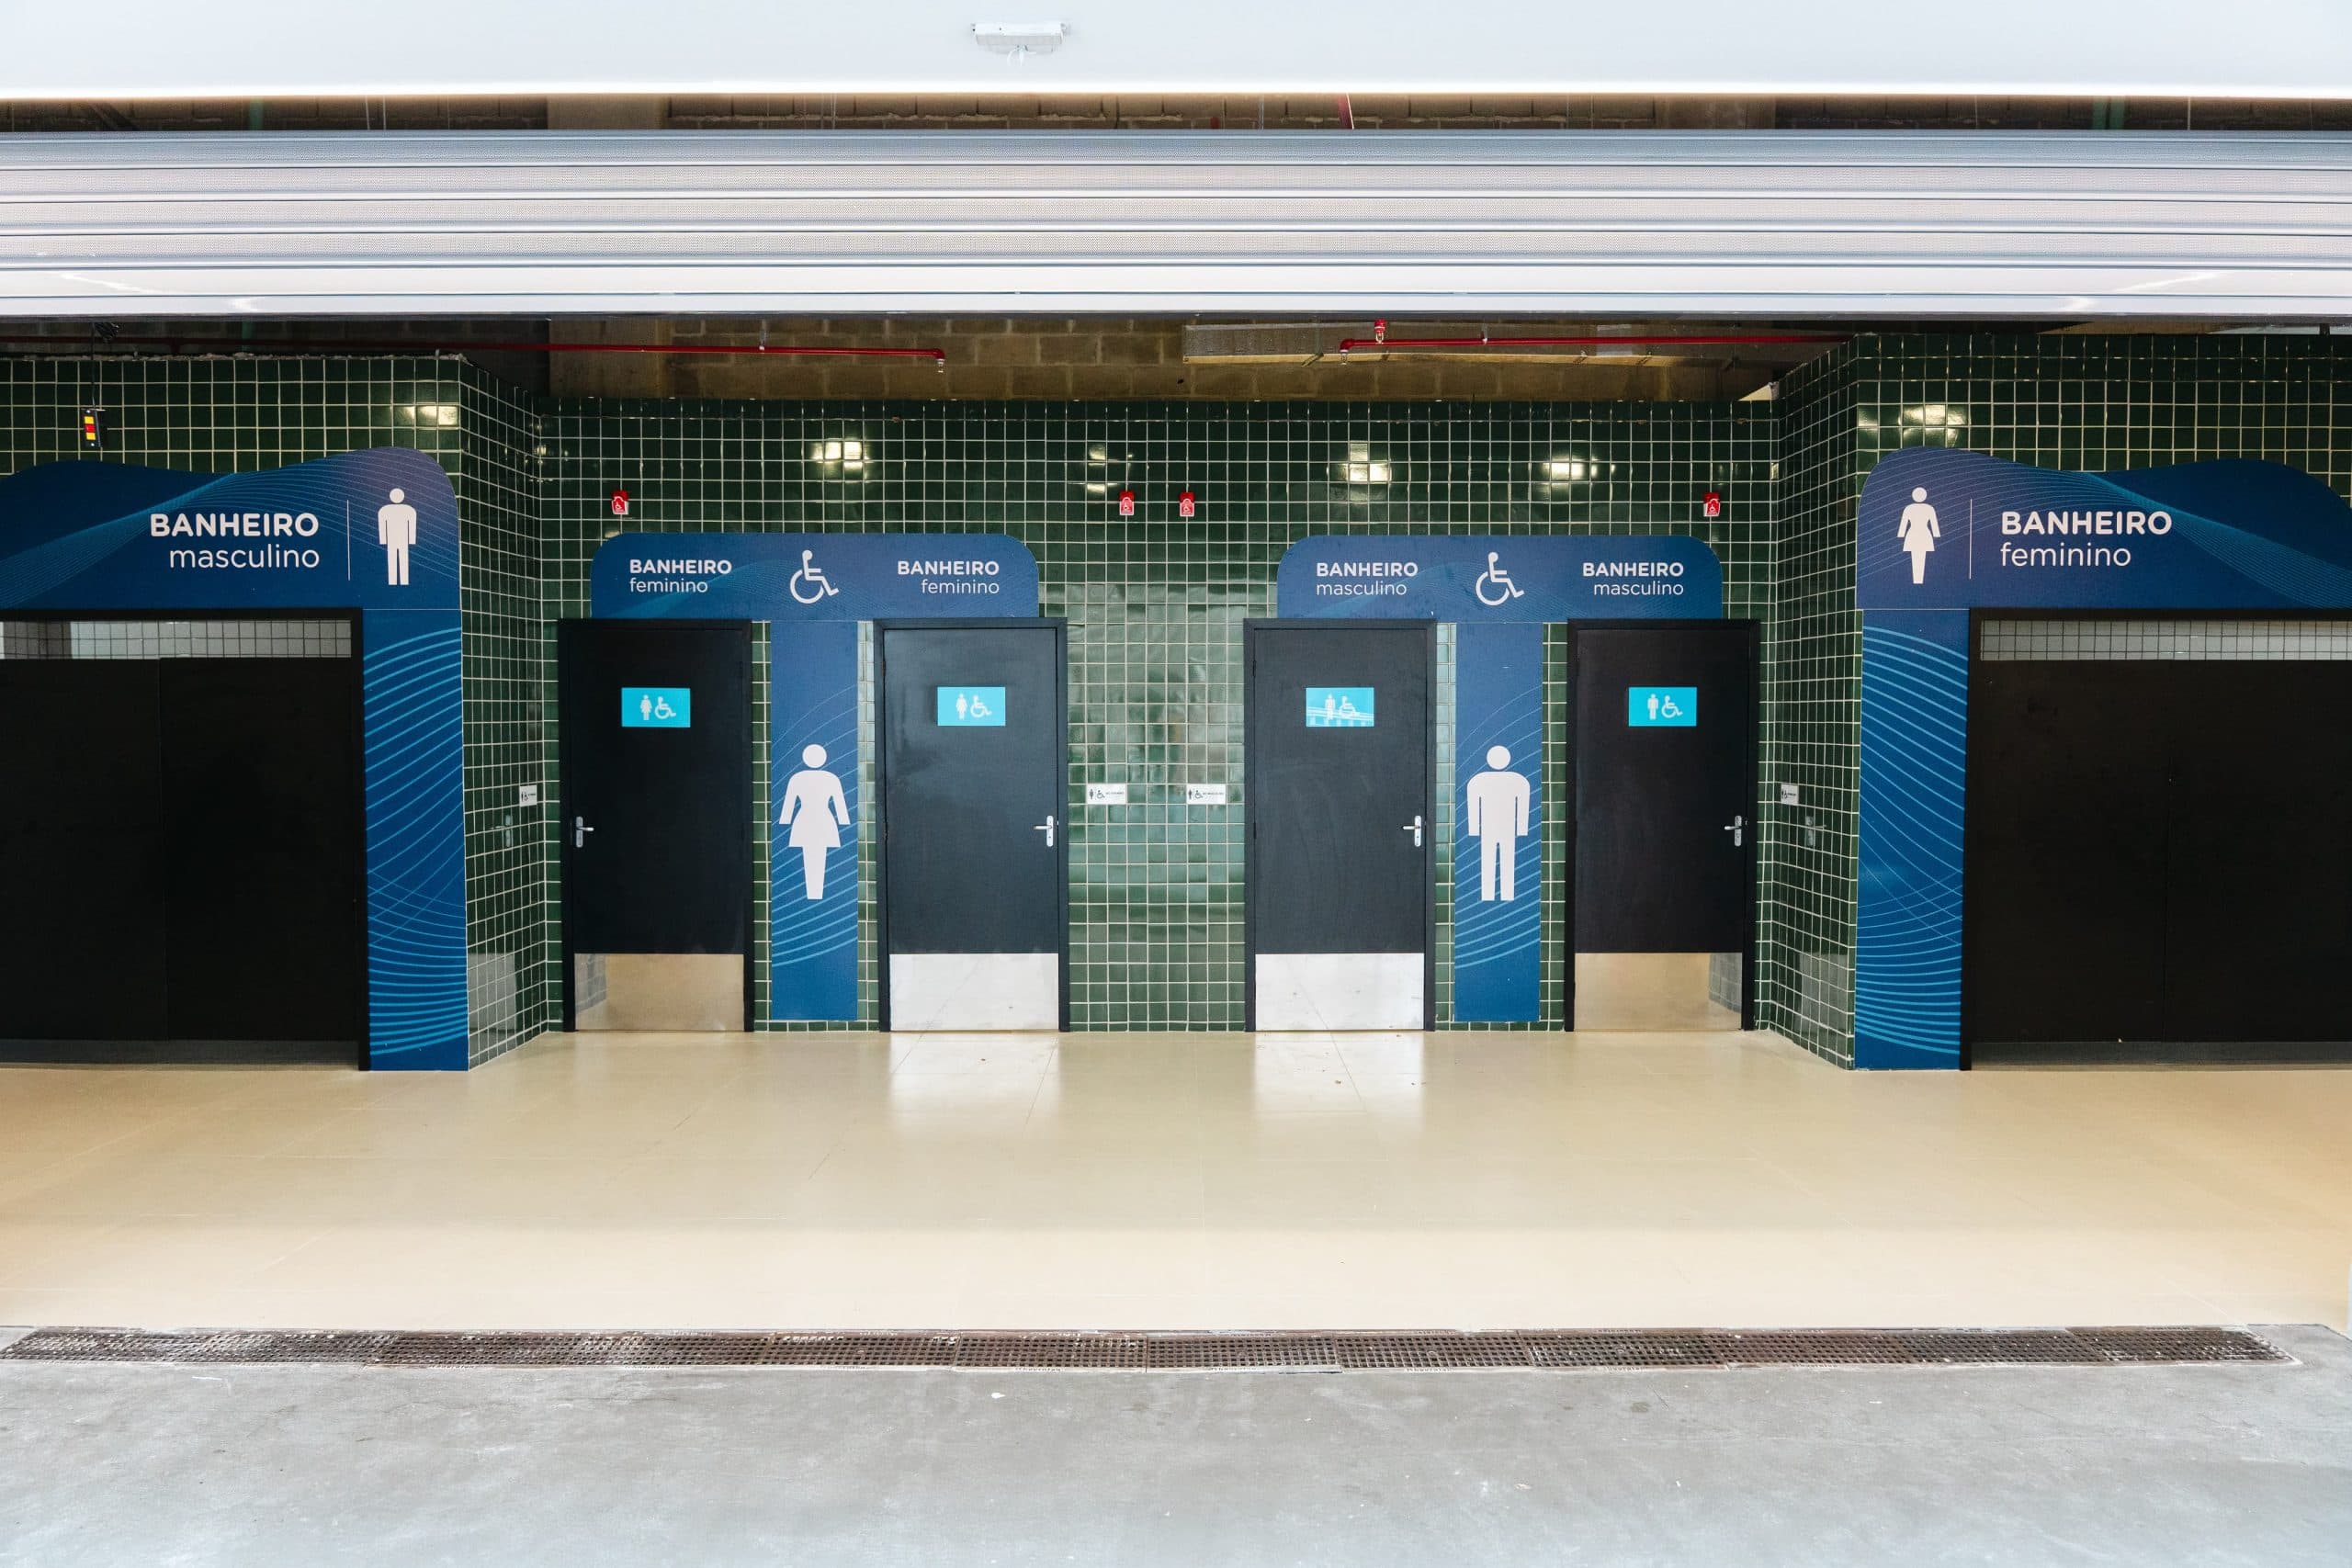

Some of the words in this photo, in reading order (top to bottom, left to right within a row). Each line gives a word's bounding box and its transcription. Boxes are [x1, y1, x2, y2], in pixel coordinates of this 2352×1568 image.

[151, 513, 319, 537] BANHEIRO
[2001, 511, 2172, 536] BANHEIRO
[170, 543, 320, 569] masculino
[2000, 541, 2132, 567] feminino
[629, 558, 732, 574] BANHEIRO
[897, 560, 1000, 576] BANHEIRO
[1317, 561, 1419, 577] BANHEIRO
[1582, 562, 1684, 577] BANHEIRO
[629, 577, 708, 593] feminino
[921, 579, 1000, 594] feminino
[1317, 580, 1408, 596] masculino
[1594, 581, 1684, 595] masculino
